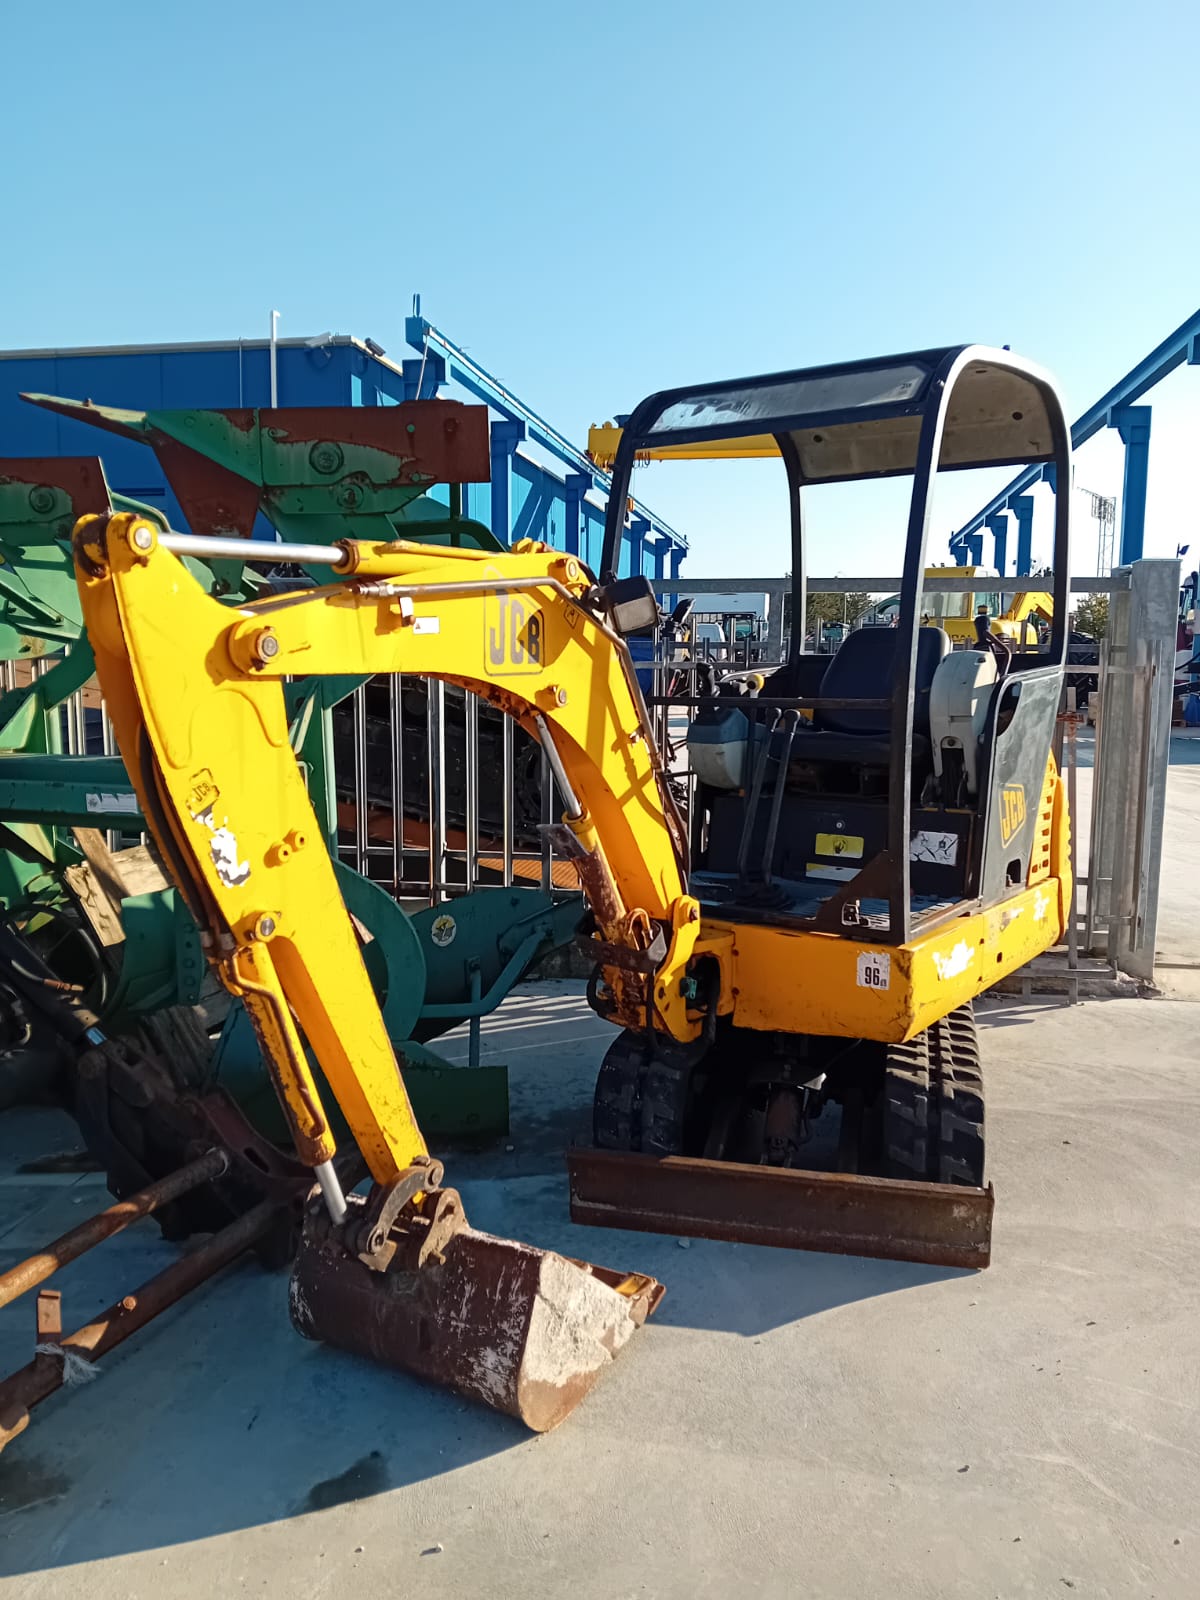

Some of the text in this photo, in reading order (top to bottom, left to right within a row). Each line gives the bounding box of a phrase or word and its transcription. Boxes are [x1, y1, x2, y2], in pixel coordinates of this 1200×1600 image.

[489, 588, 540, 665] JCB
[192, 782, 211, 802] JCB
[1001, 790, 1025, 841] JCB
[864, 966, 880, 986] 96
